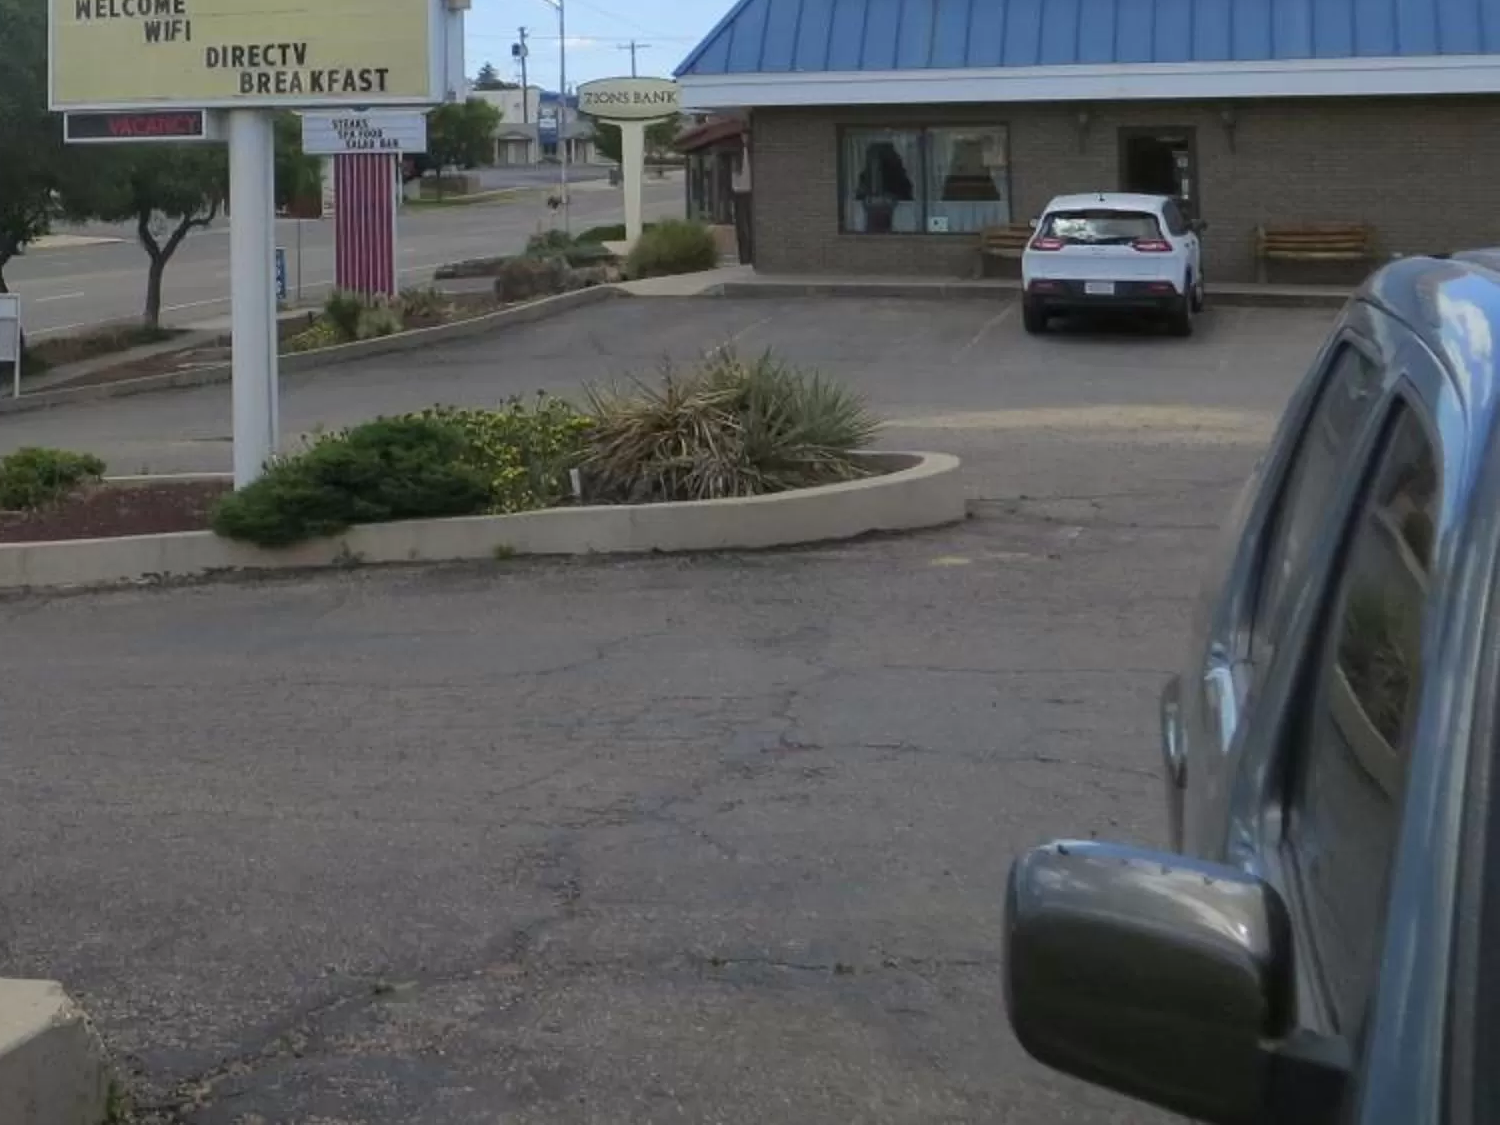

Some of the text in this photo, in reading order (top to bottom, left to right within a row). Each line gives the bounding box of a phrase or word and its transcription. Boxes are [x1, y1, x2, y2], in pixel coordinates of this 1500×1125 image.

[144, 19, 192, 43] WIFI
[205, 42, 308, 69] DIRECTV
[238, 67, 390, 95] BREAKFAST
[583, 91, 676, 104] ZIONS BANK
[108, 113, 199, 137] VACANCY
